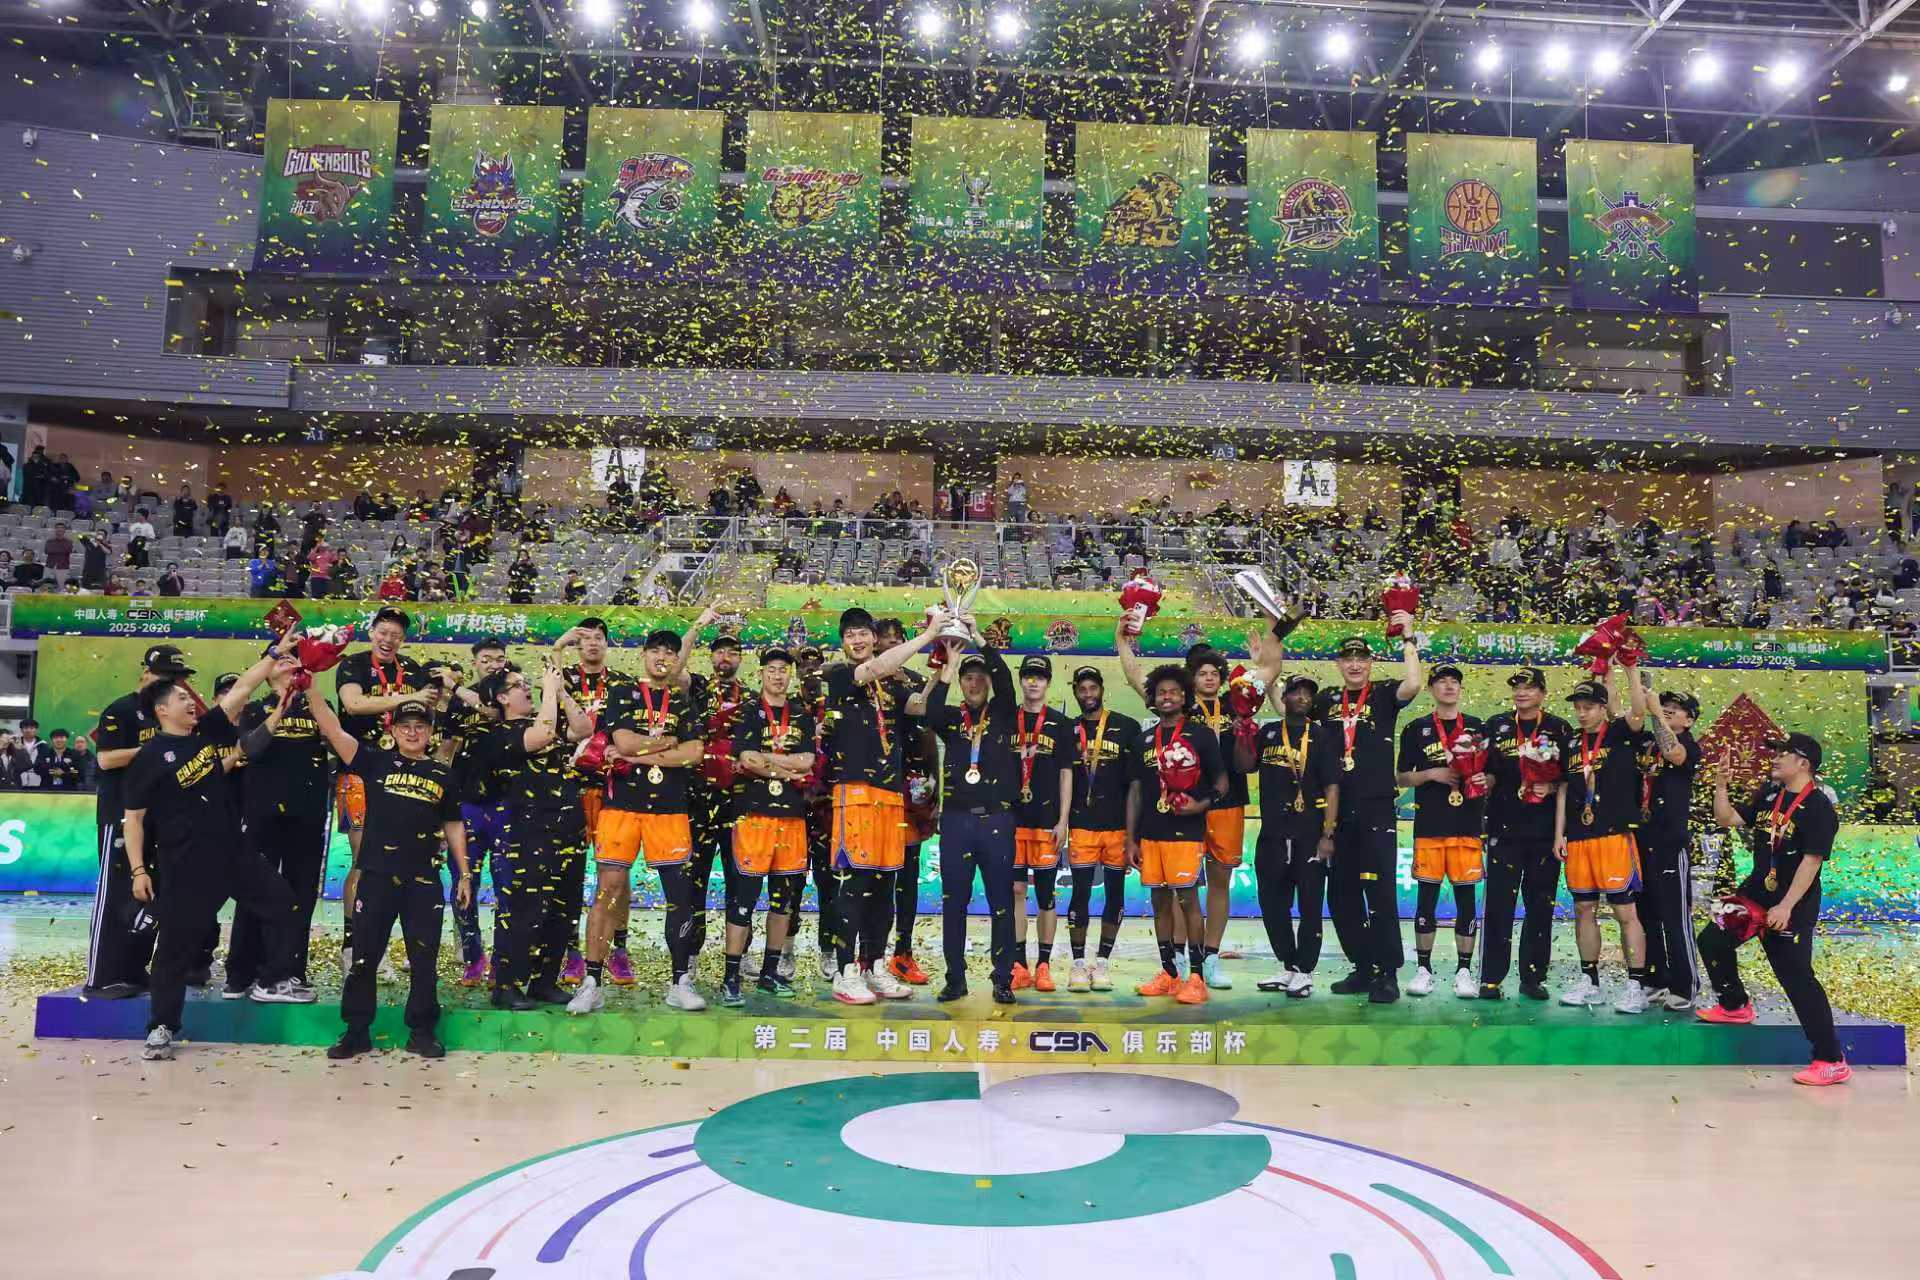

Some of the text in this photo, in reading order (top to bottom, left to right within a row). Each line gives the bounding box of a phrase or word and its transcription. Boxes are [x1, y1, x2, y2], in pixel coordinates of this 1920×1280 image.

[754, 1024, 848, 1051] 第二届
[1029, 1031, 1110, 1054] CBA
[1121, 1029, 1247, 1056] 俱乐部杯
